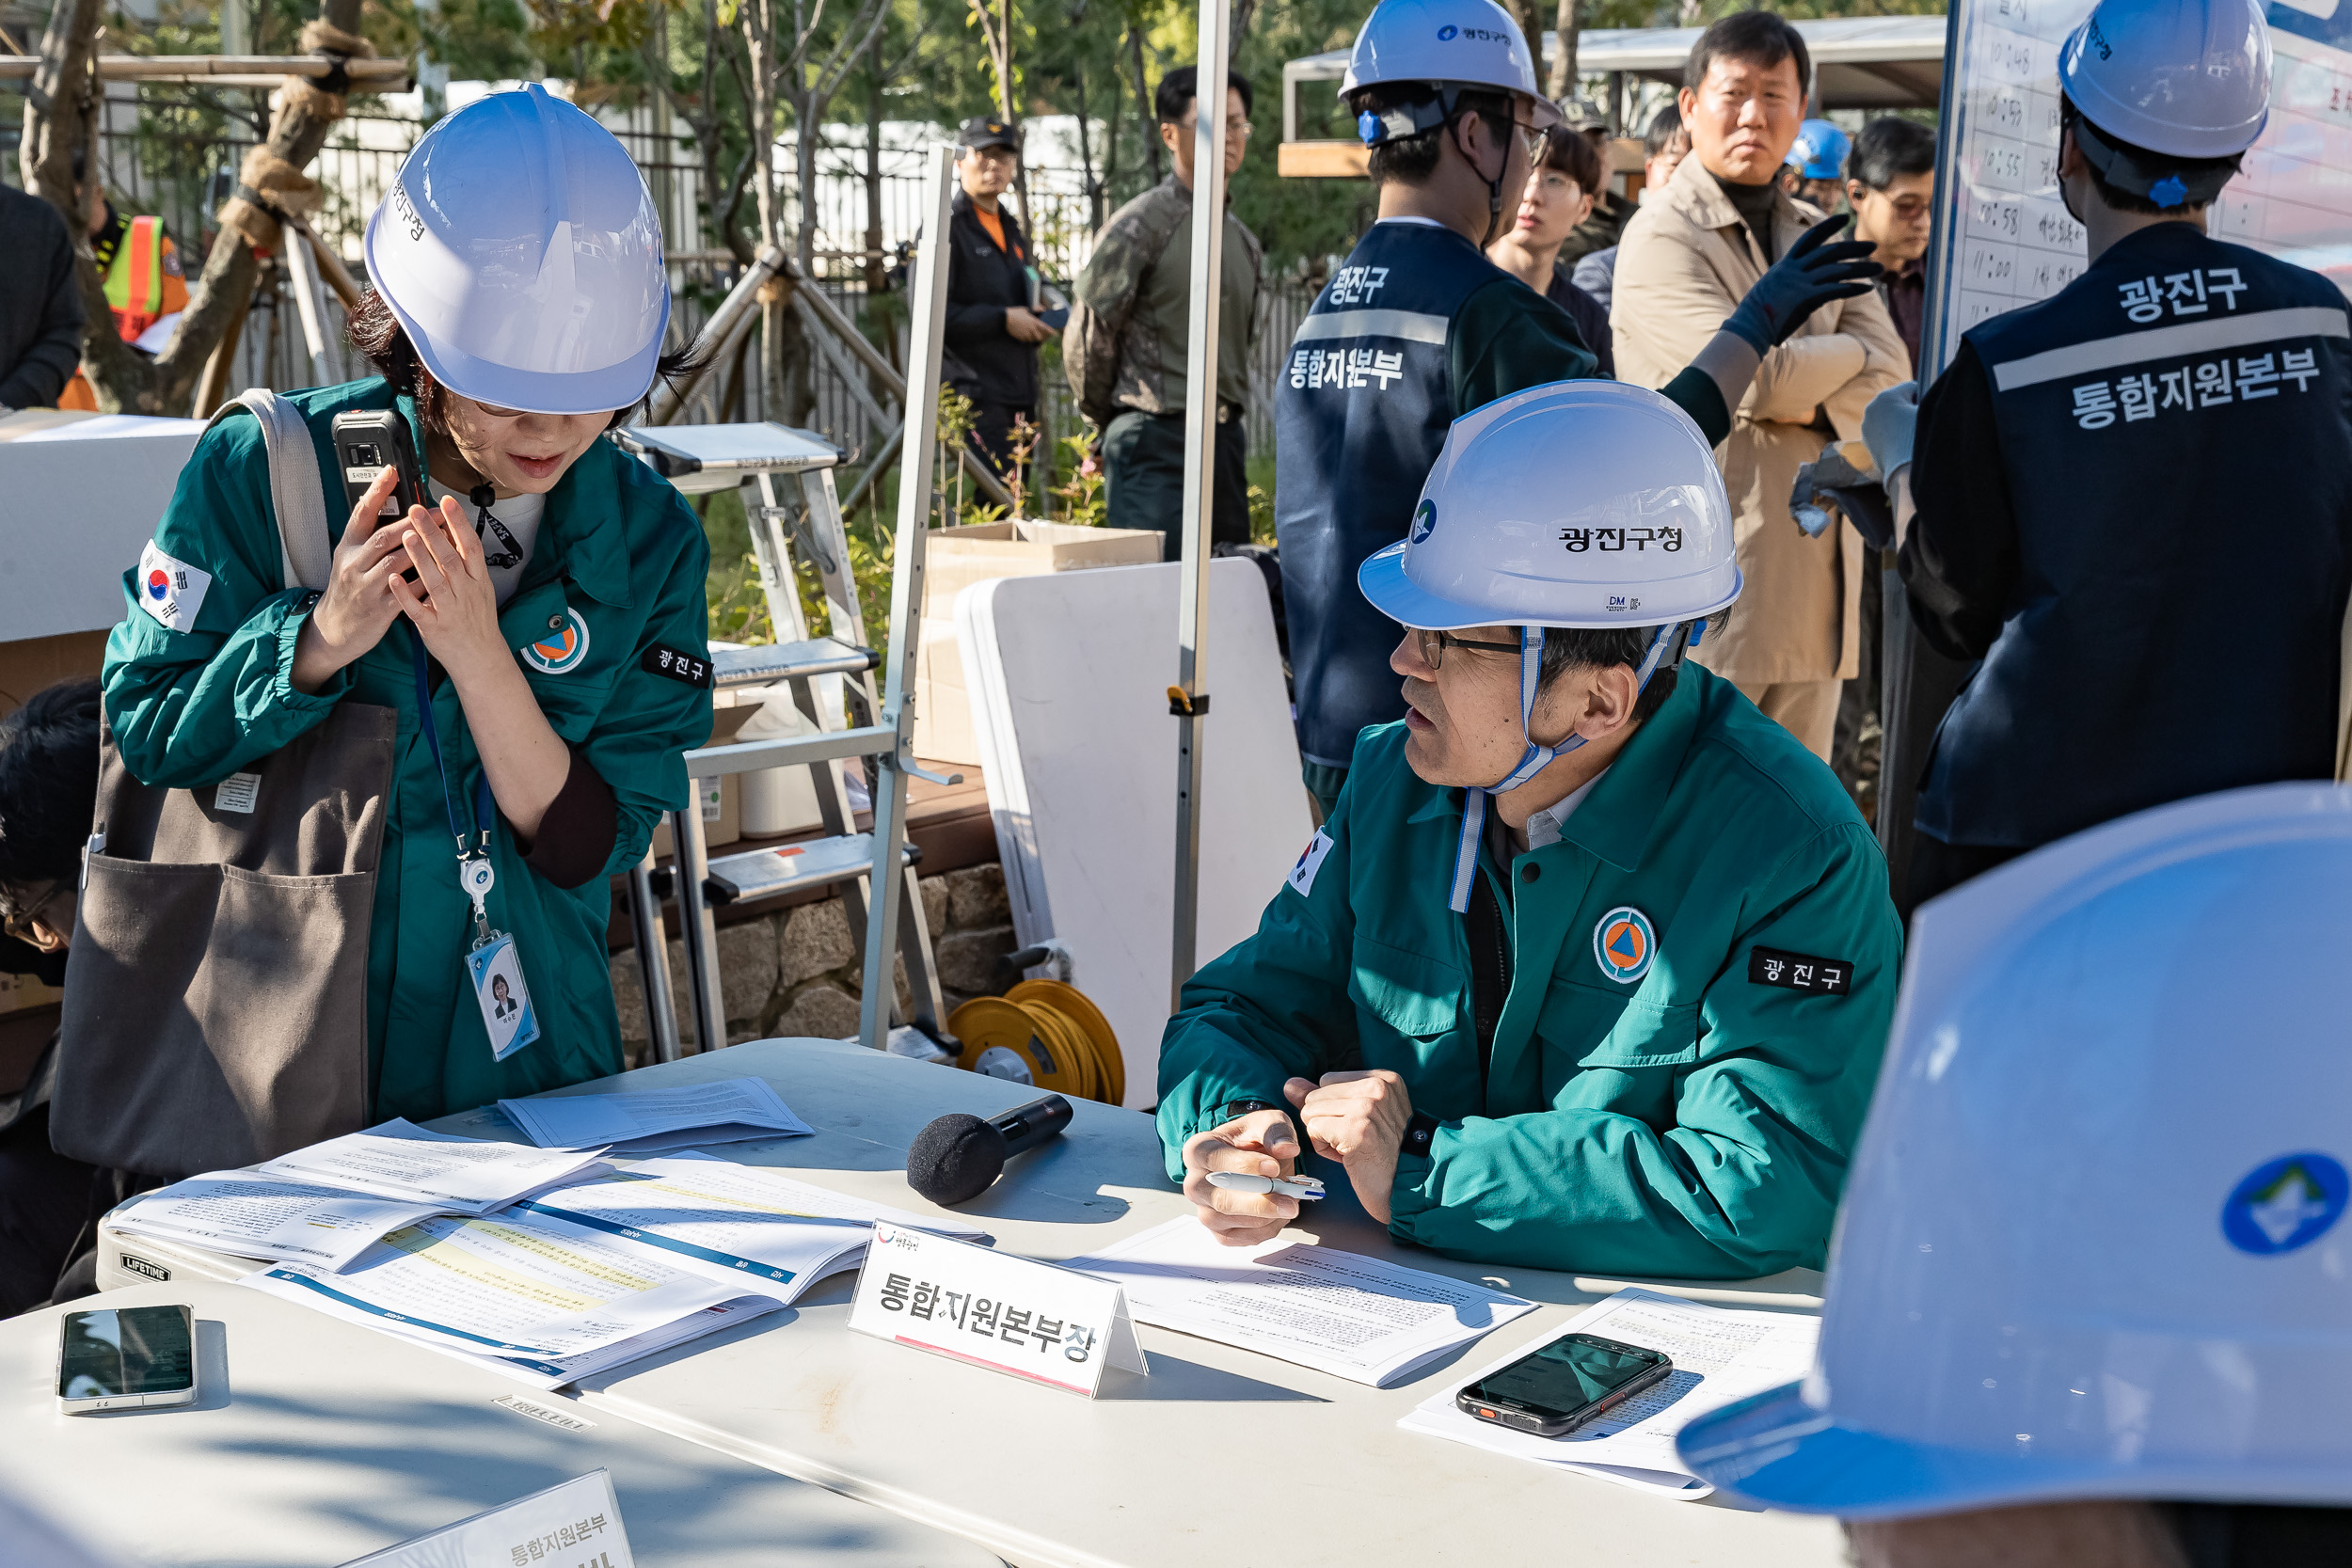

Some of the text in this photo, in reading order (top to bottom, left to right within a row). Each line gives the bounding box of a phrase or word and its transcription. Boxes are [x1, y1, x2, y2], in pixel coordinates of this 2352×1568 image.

[1329, 265, 1390, 306] 광진구
[2118, 267, 2249, 324] 광진구
[1290, 347, 1404, 391] 통합지원본부
[2073, 347, 2321, 430] 통합지원본부
[1559, 526, 1683, 553] 광진구청
[1610, 596, 1625, 605] DM
[659, 649, 704, 680] 광진구
[1763, 958, 1841, 990] 광진구
[126, 1259, 166, 1280] LIFETIME
[880, 1273, 1097, 1363] 통합지원본부장
[510, 1513, 608, 1567] 통합지원본부
